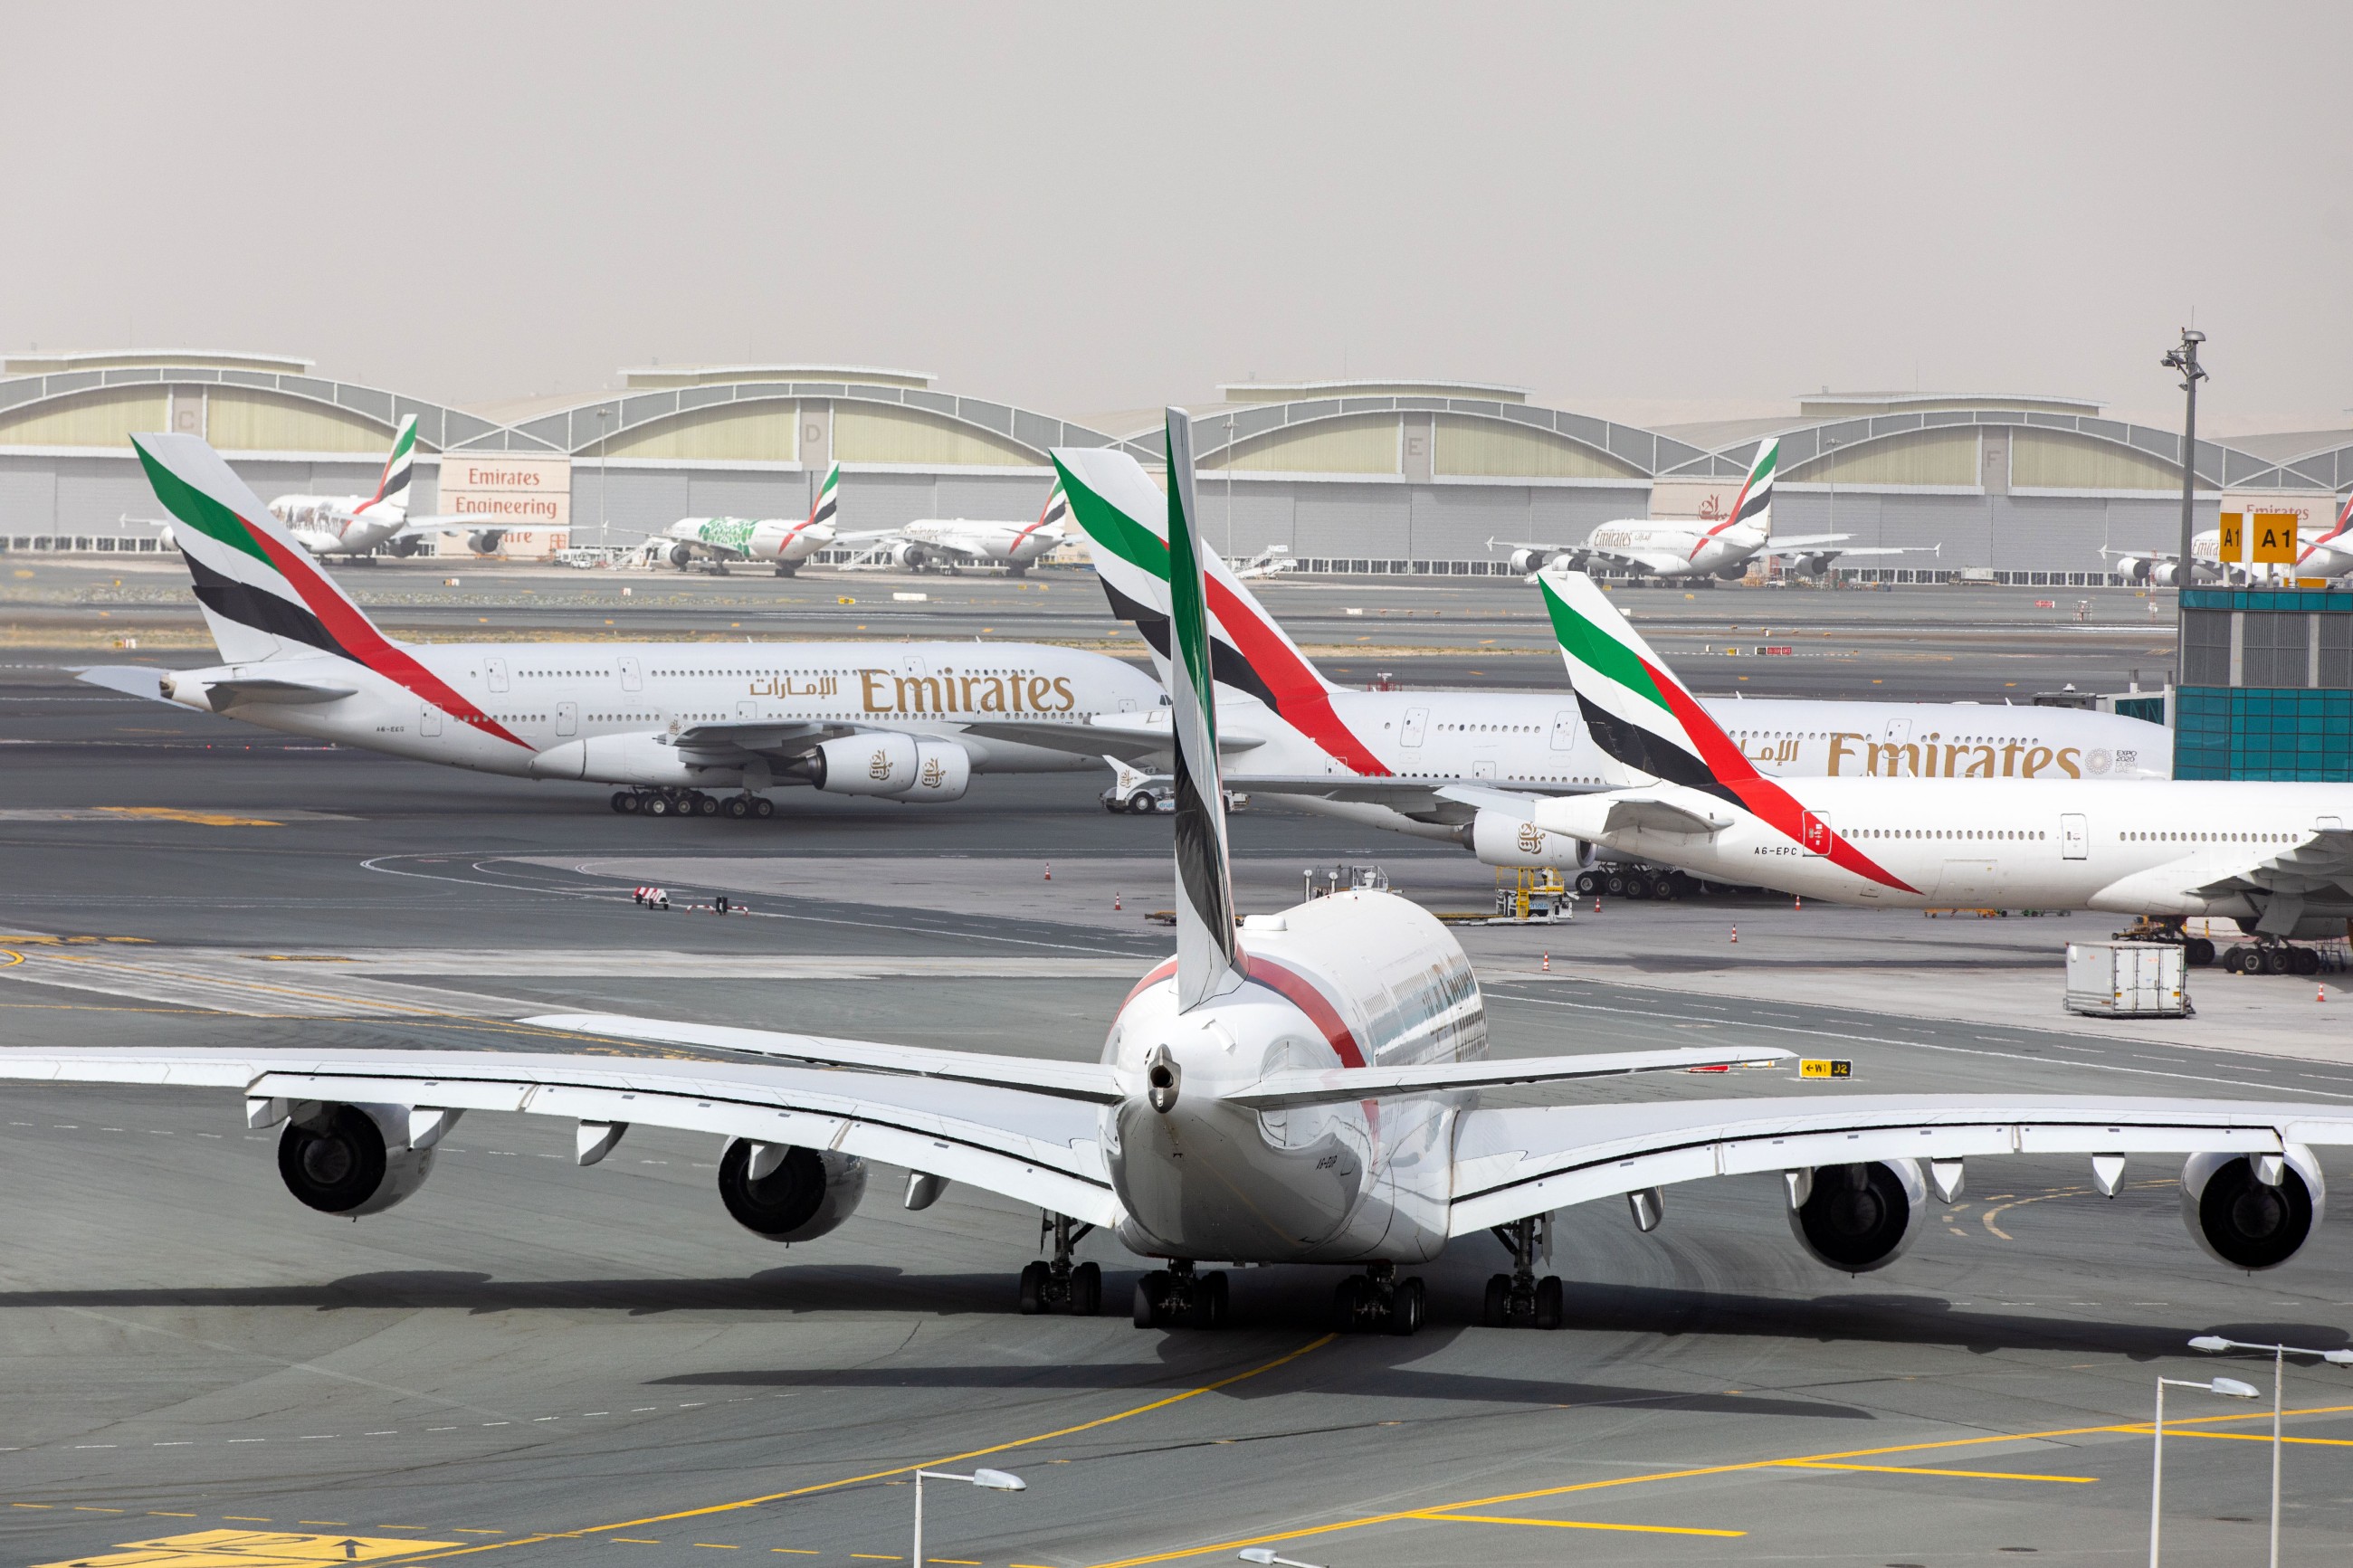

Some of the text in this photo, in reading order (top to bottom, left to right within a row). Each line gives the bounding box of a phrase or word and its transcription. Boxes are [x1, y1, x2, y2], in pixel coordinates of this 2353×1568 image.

[805, 423, 821, 443] D
[1408, 437, 1423, 456] E
[1986, 450, 2001, 468] F
[469, 468, 539, 486] Emirates
[455, 497, 557, 519] Engineering
[1594, 528, 1632, 547] Emirates
[2224, 527, 2240, 547] A1
[2261, 528, 2291, 548] A1
[2192, 538, 2219, 556] Emira
[858, 667, 1075, 713] Emirates
[1754, 847, 1797, 856] A6-EPC
[1815, 1063, 1848, 1075] W1 J2
